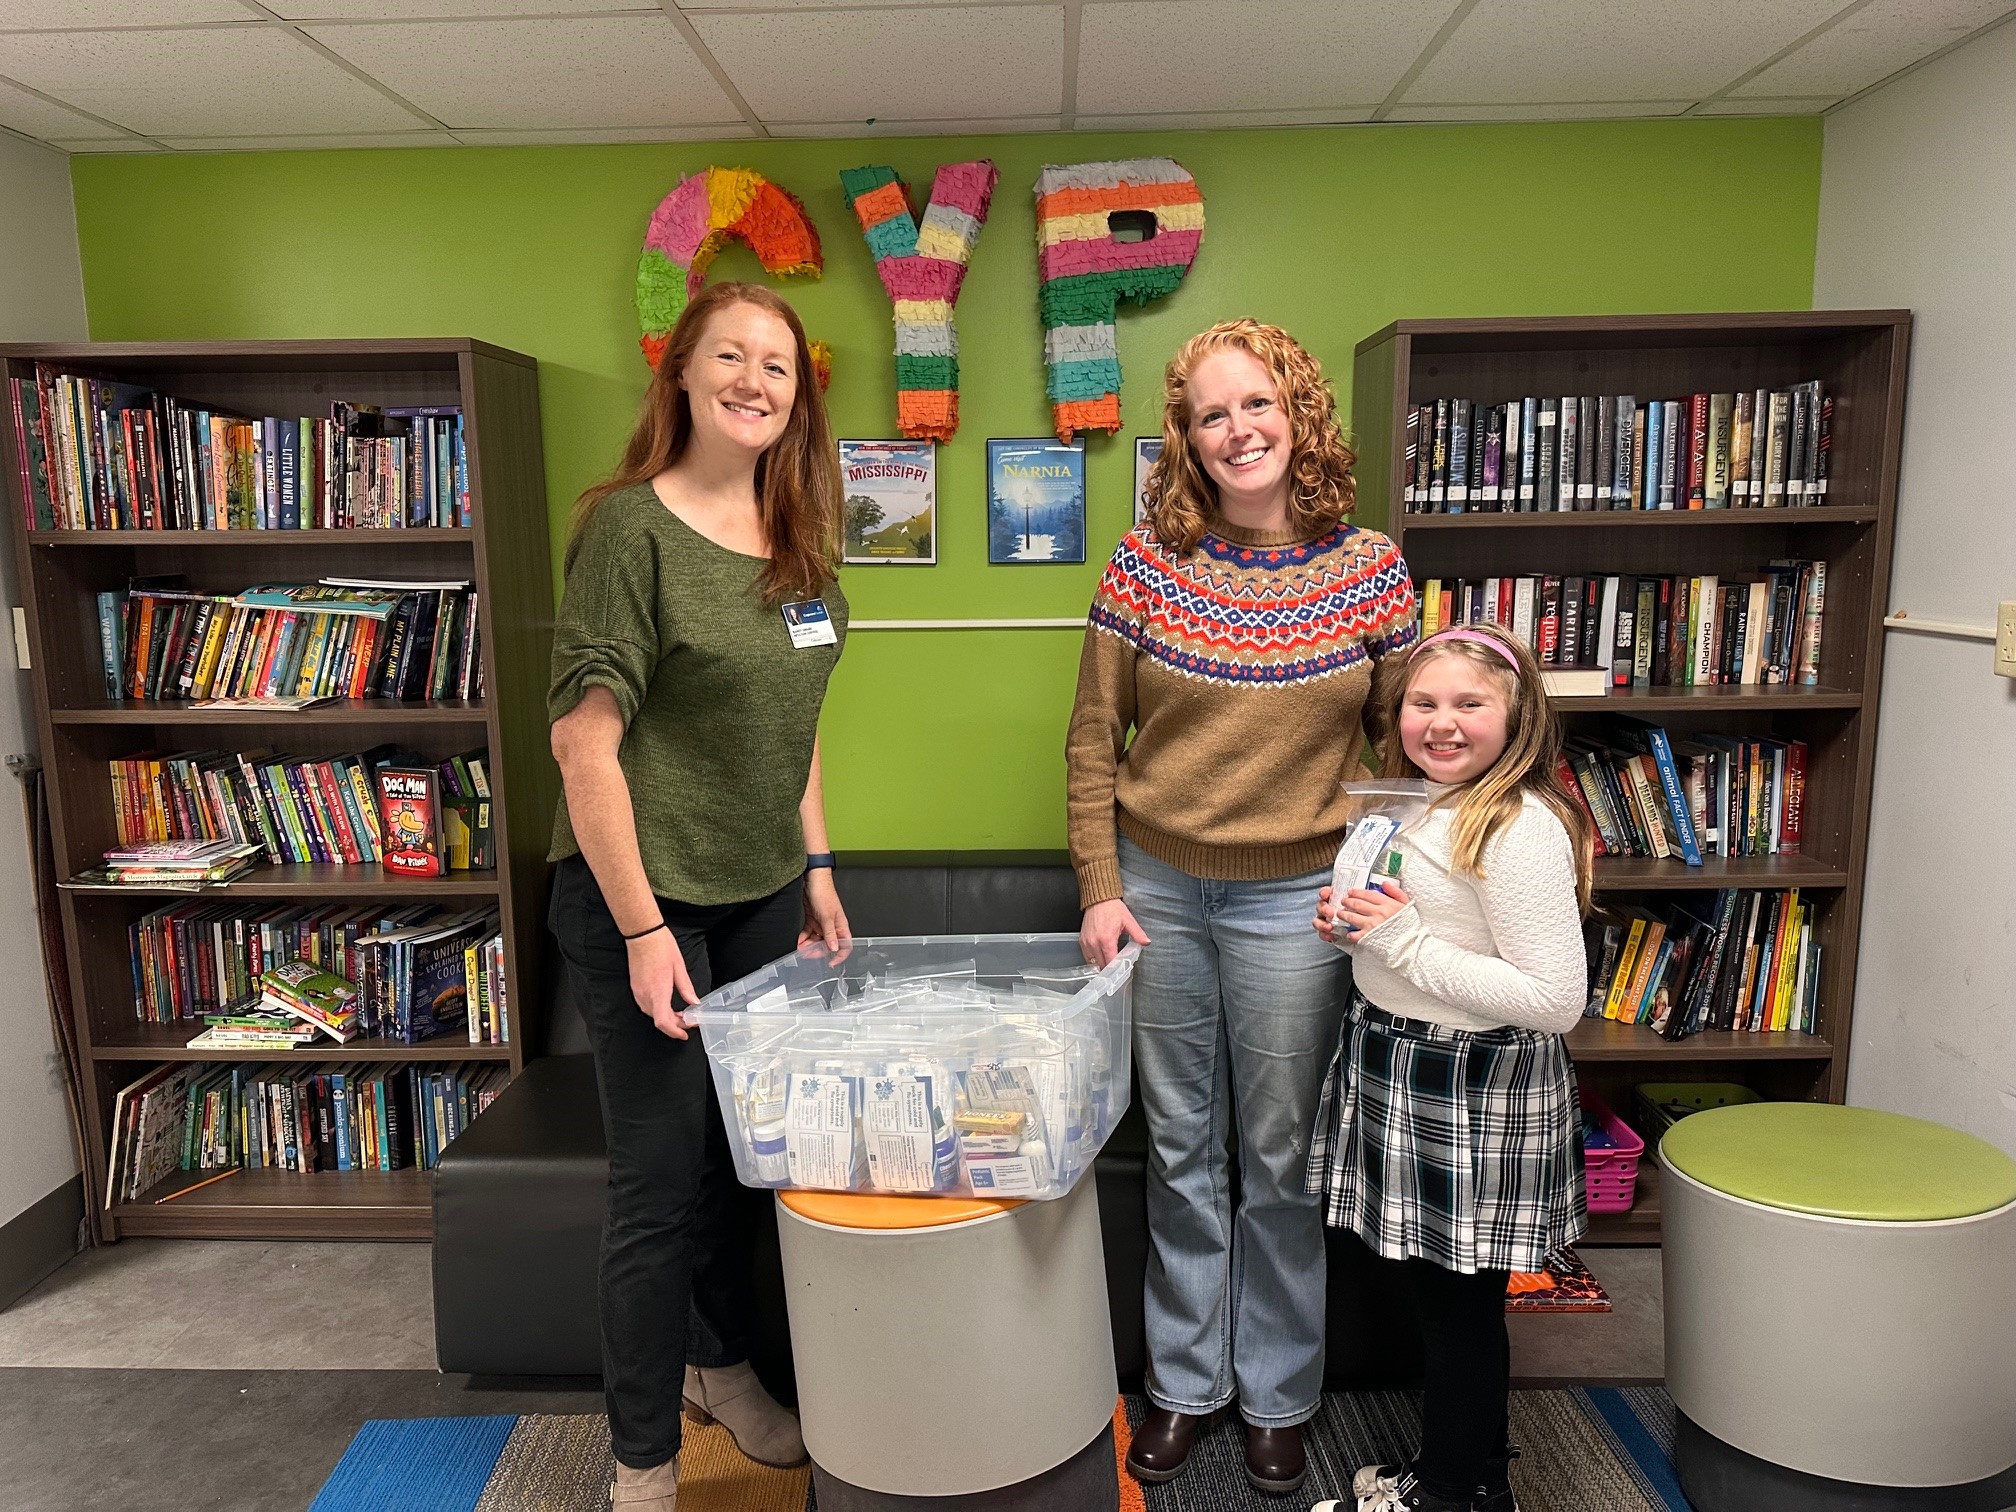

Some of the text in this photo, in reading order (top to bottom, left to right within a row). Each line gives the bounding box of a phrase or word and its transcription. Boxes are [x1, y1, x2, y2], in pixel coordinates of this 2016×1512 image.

[1775, 396, 1788, 404] FOR
[1775, 405, 1787, 413] THE
[1775, 414, 1787, 422] WIN
[1432, 438, 1441, 471] FORCE
[1475, 419, 1484, 450] GATEWAY
[1619, 419, 1632, 489] DIVERGENT
[1715, 417, 1728, 487] INSURGENT
[1773, 441, 1782, 458] CORY
[266, 457, 275, 493] EXTINCTS
[848, 465, 927, 482] MISSISSIPPI
[1003, 464, 1072, 479] NARNIA
[1523, 433, 1535, 478] COLD CALLS
[1541, 441, 1552, 477] OUTPOST
[1693, 451, 1705, 485] ANGEL
[282, 448, 293, 505] LITTLE WOMEN
[101, 617, 113, 662] WONDER
[208, 629, 216, 639] Life
[211, 619, 218, 629] My
[1542, 600, 1557, 661] requiem
[1564, 601, 1577, 662] PARTIALS
[1617, 611, 1633, 647] ASHES
[1638, 607, 1650, 671] INSURGENT
[1736, 612, 1746, 660] RAIN REIGN
[362, 638, 374, 668] TWERP
[386, 620, 404, 679] MY PLAIN JANE
[1701, 622, 1711, 674] CHAMPION
[382, 776, 426, 795] DOG MAN
[1663, 766, 1691, 845] animal FACT FINDER
[1787, 768, 1801, 832] ALLEGIANT
[330, 792, 338, 806] WITH
[337, 815, 346, 830] FLOW
[343, 790, 352, 805] Kate
[352, 816, 361, 834] Great
[1639, 784, 1665, 848] DEADLANDS HUNTED
[1694, 781, 1705, 832] delirium
[1705, 895, 1734, 993] GUINNESS WORLD RECORDS
[356, 967, 365, 1020] DIVERGENT
[479, 971, 490, 1012] WILLODEEN
[1630, 941, 1656, 1006] LOOK ON THE BRIGHT SIDE
[334, 1102, 346, 1159] panda-monium
[387, 1105, 397, 1135] ENCLAVE
[447, 1103, 455, 1140] MOCKINGJAY
[964, 1110, 1007, 1119] HONEES
